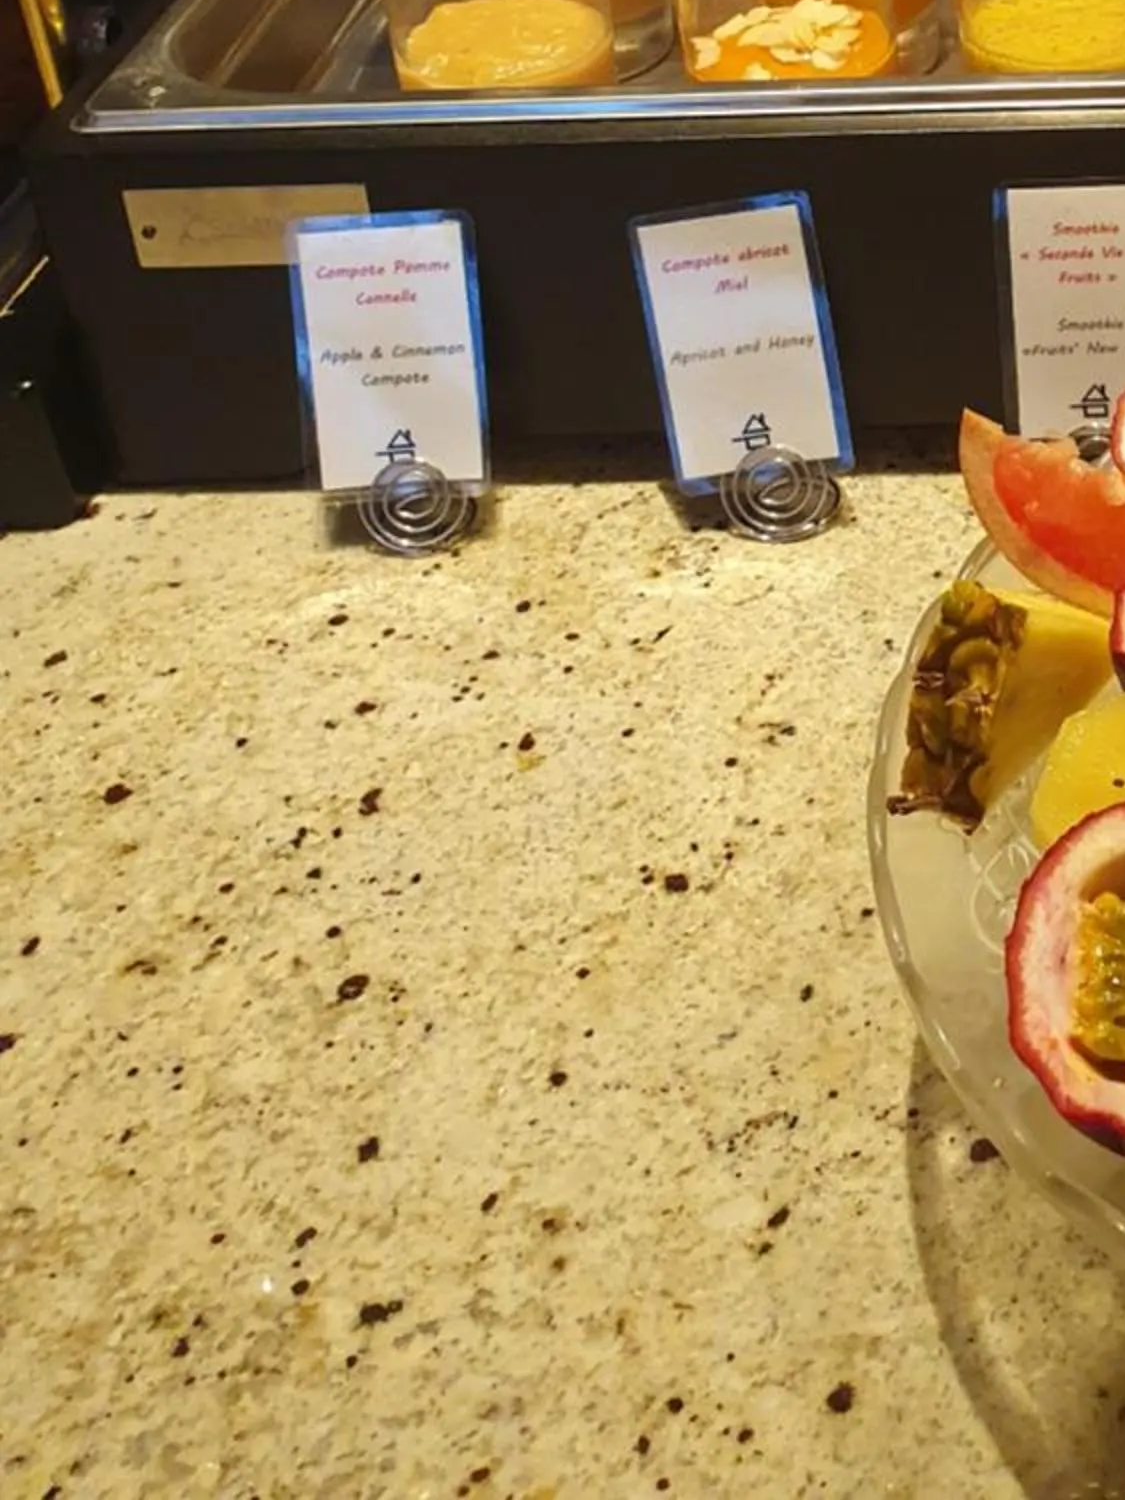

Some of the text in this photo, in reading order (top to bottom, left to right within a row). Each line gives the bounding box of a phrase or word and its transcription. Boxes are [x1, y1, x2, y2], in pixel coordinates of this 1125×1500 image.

[1052, 221, 1120, 235] Smoothie
[661, 243, 791, 274] Compote abricot
[1038, 246, 1094, 261] Seconde
[1101, 245, 1123, 259] Vie
[316, 259, 450, 281] Compote Pomme
[1058, 271, 1101, 283] Fruits
[714, 277, 748, 293] Miel
[355, 290, 417, 306] Cannelle
[1057, 317, 1124, 332] Smoothie
[320, 342, 466, 365] Apple & Cinnamon
[669, 334, 815, 368] Apricot and Honey
[1086, 341, 1118, 355] New
[361, 372, 430, 388] Compote
